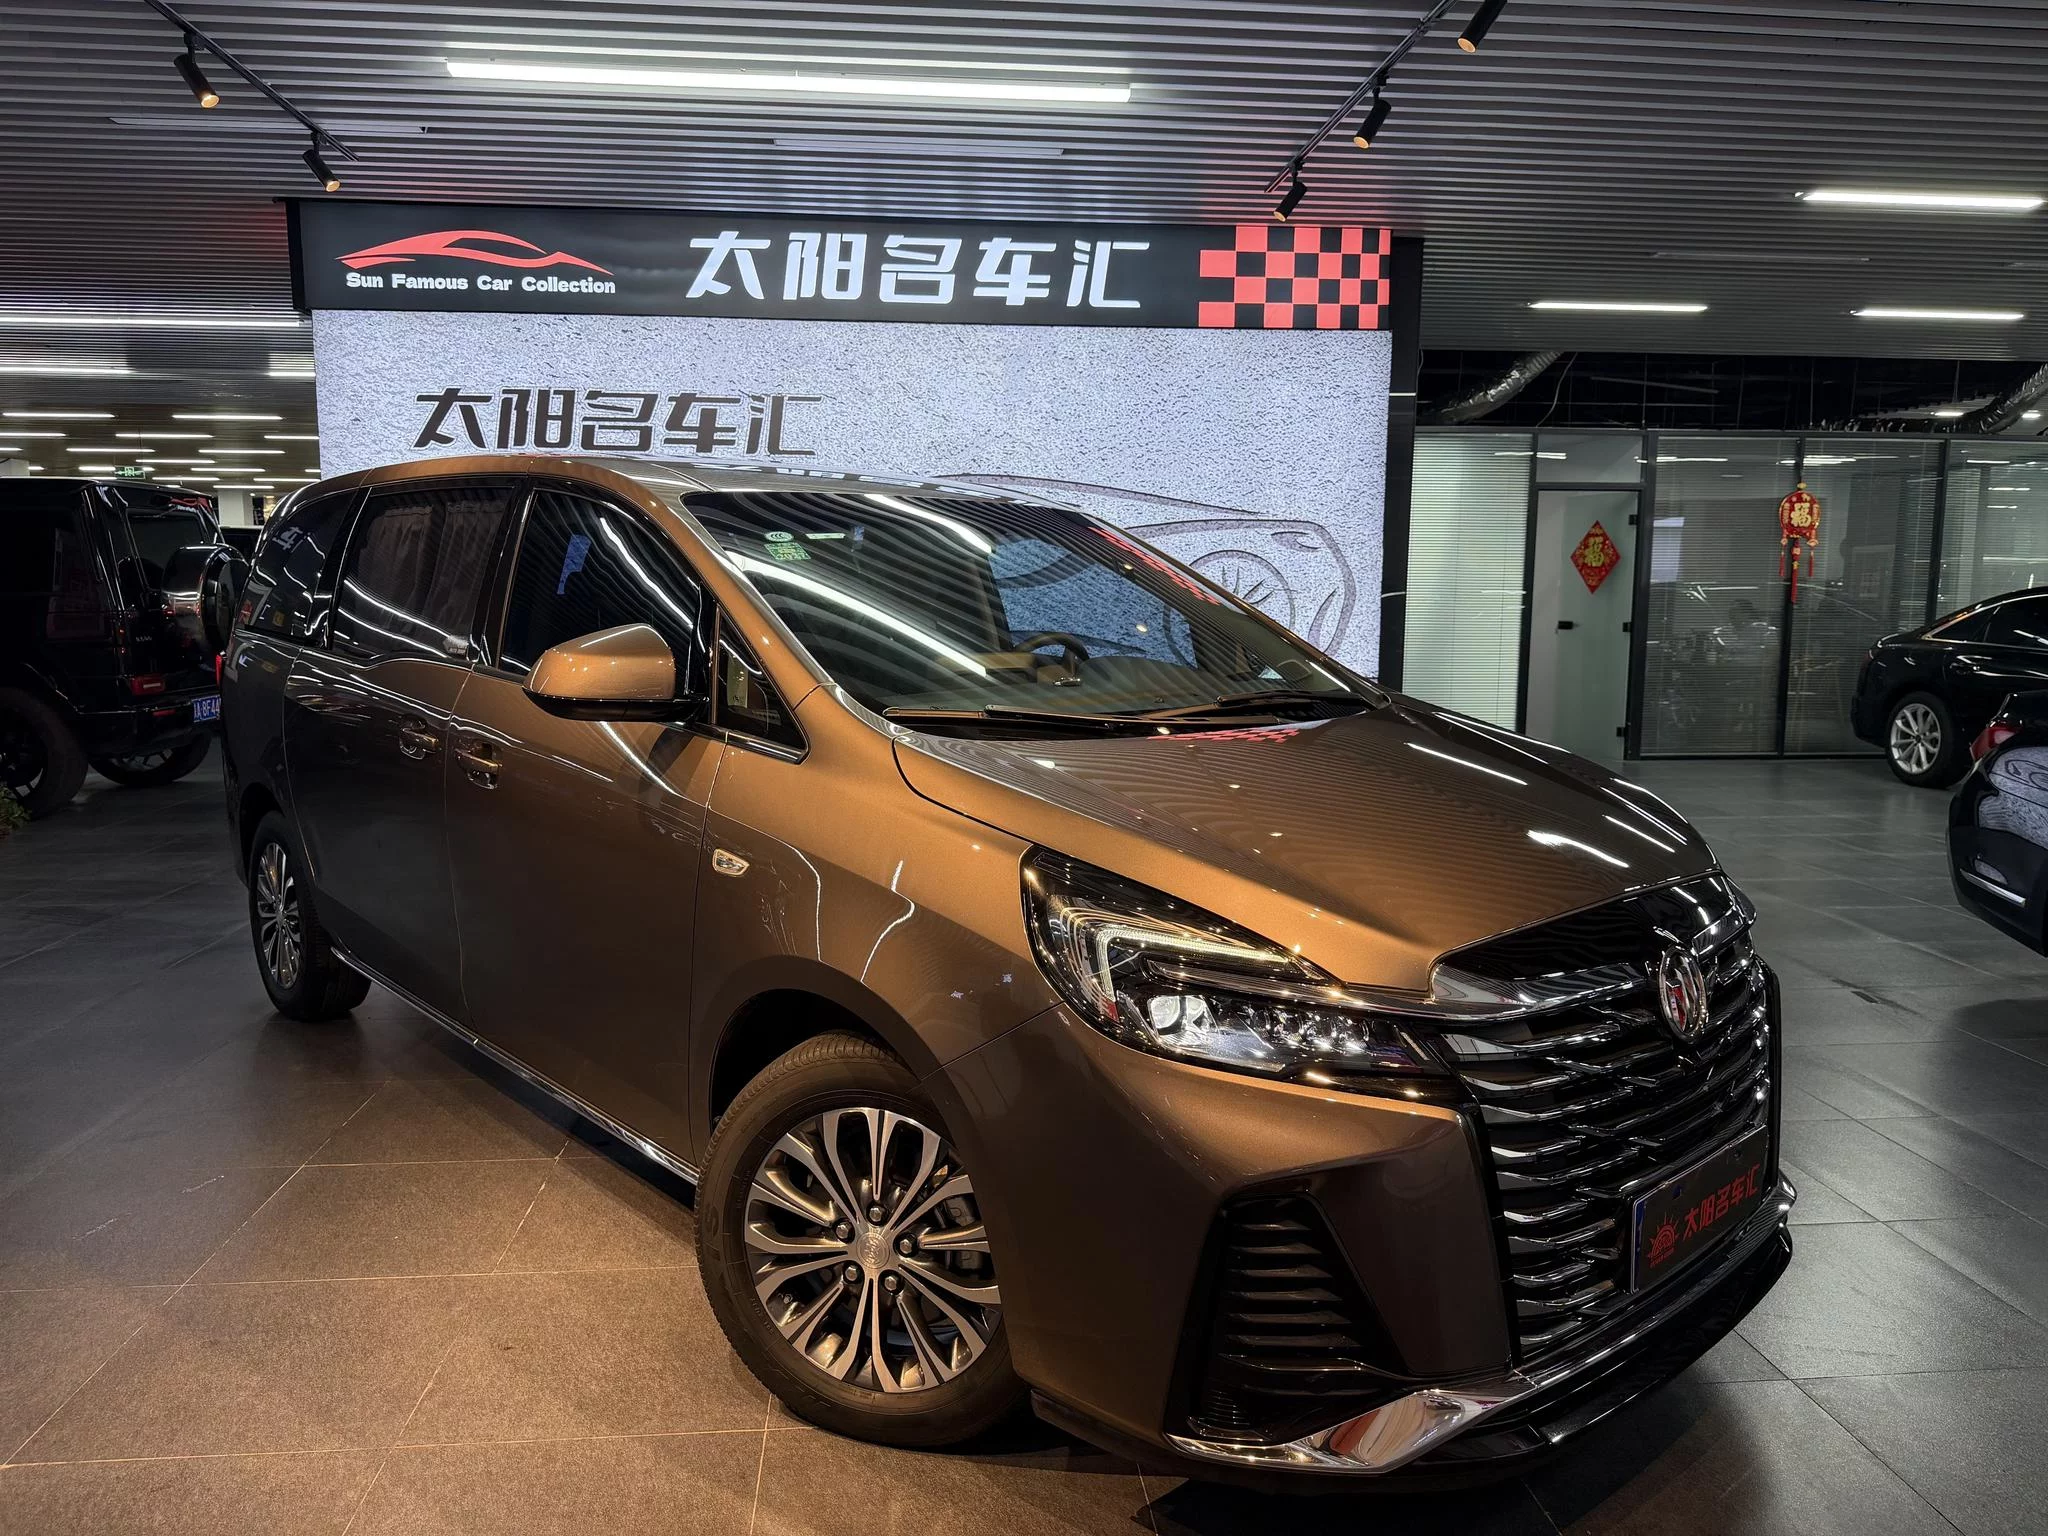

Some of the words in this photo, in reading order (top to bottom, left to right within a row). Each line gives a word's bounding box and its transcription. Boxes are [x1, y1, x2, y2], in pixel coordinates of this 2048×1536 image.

[346, 272, 383, 288] Sun
[392, 273, 468, 290] Famous
[477, 275, 513, 291] Car
[521, 276, 616, 294] Collection
[686, 230, 1150, 309] 太阳名车汇
[413, 387, 823, 456] 太阳名车汇
[1790, 502, 1812, 528] 福
[1682, 1162, 1761, 1241] 太阳名车汇
